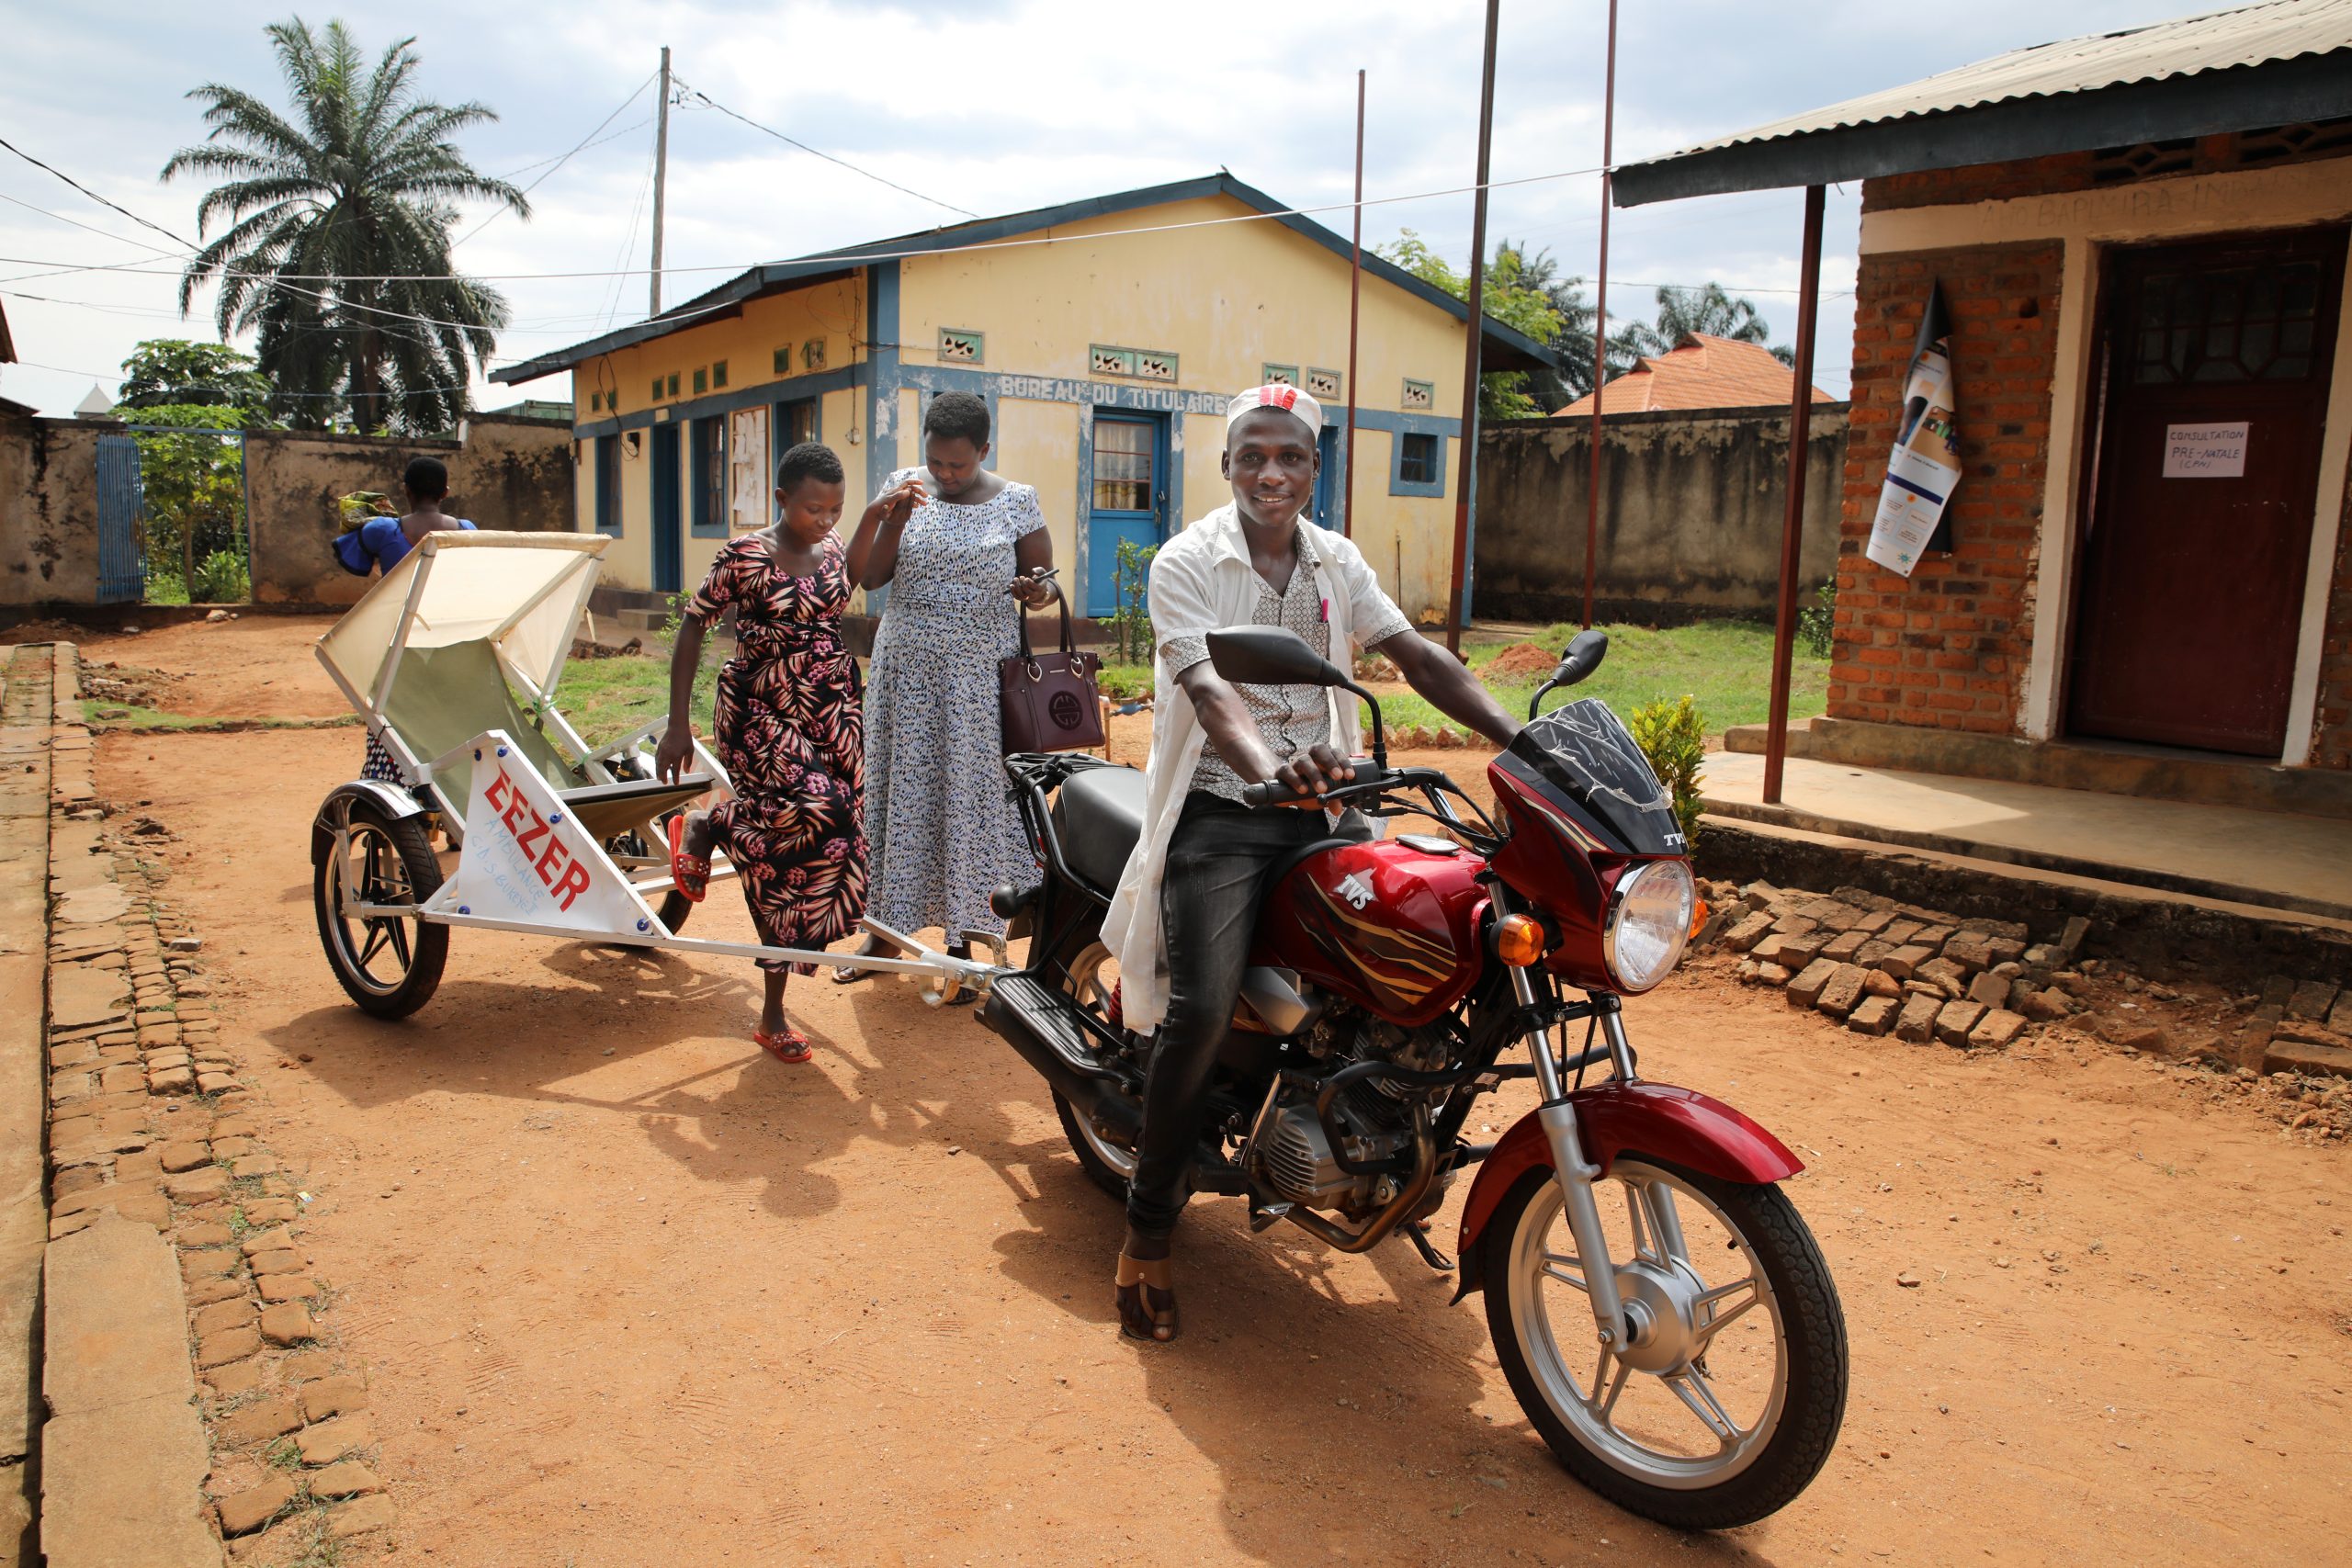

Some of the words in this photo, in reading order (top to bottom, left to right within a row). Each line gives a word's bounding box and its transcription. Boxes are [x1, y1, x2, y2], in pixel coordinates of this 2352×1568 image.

[1000, 376, 1081, 401] BUREAU
[1092, 384, 1117, 405] DU
[1130, 387, 1227, 415] TITULAIRE
[2169, 430, 2245, 441] CONSULTATION
[484, 763, 591, 912] EEZER
[484, 818, 546, 901] AMBULANCE
[1337, 874, 1374, 910] TVS
